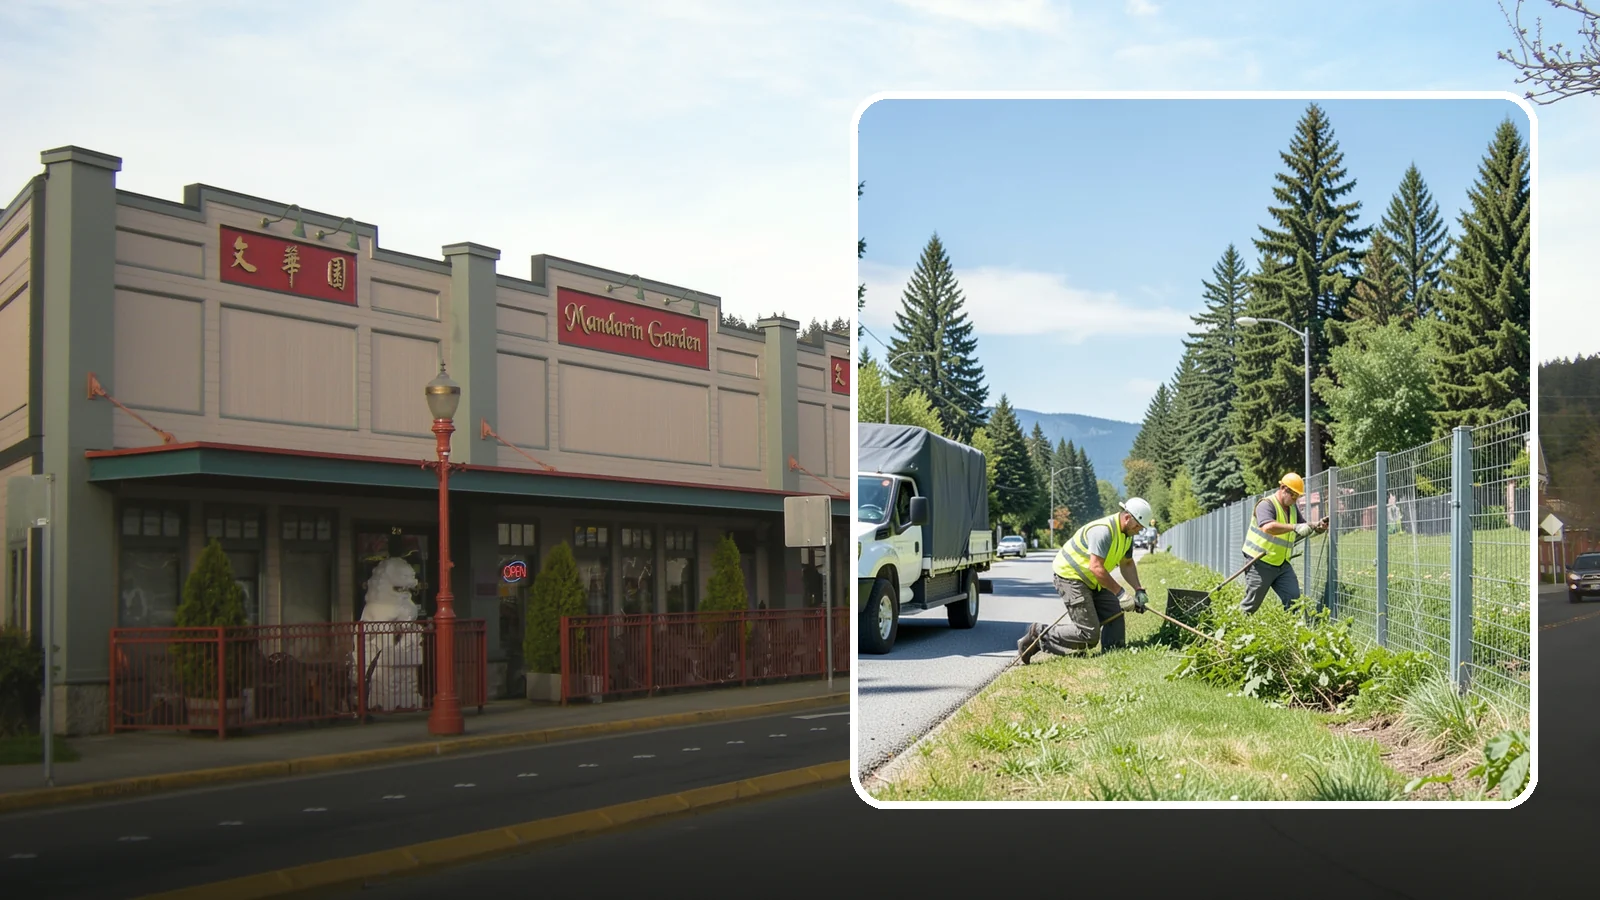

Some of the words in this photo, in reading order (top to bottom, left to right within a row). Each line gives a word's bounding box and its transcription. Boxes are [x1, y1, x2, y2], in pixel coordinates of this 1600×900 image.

[564, 302, 644, 341] Mandarin
[648, 320, 701, 352] Garden
[503, 565, 527, 578] OPEN
